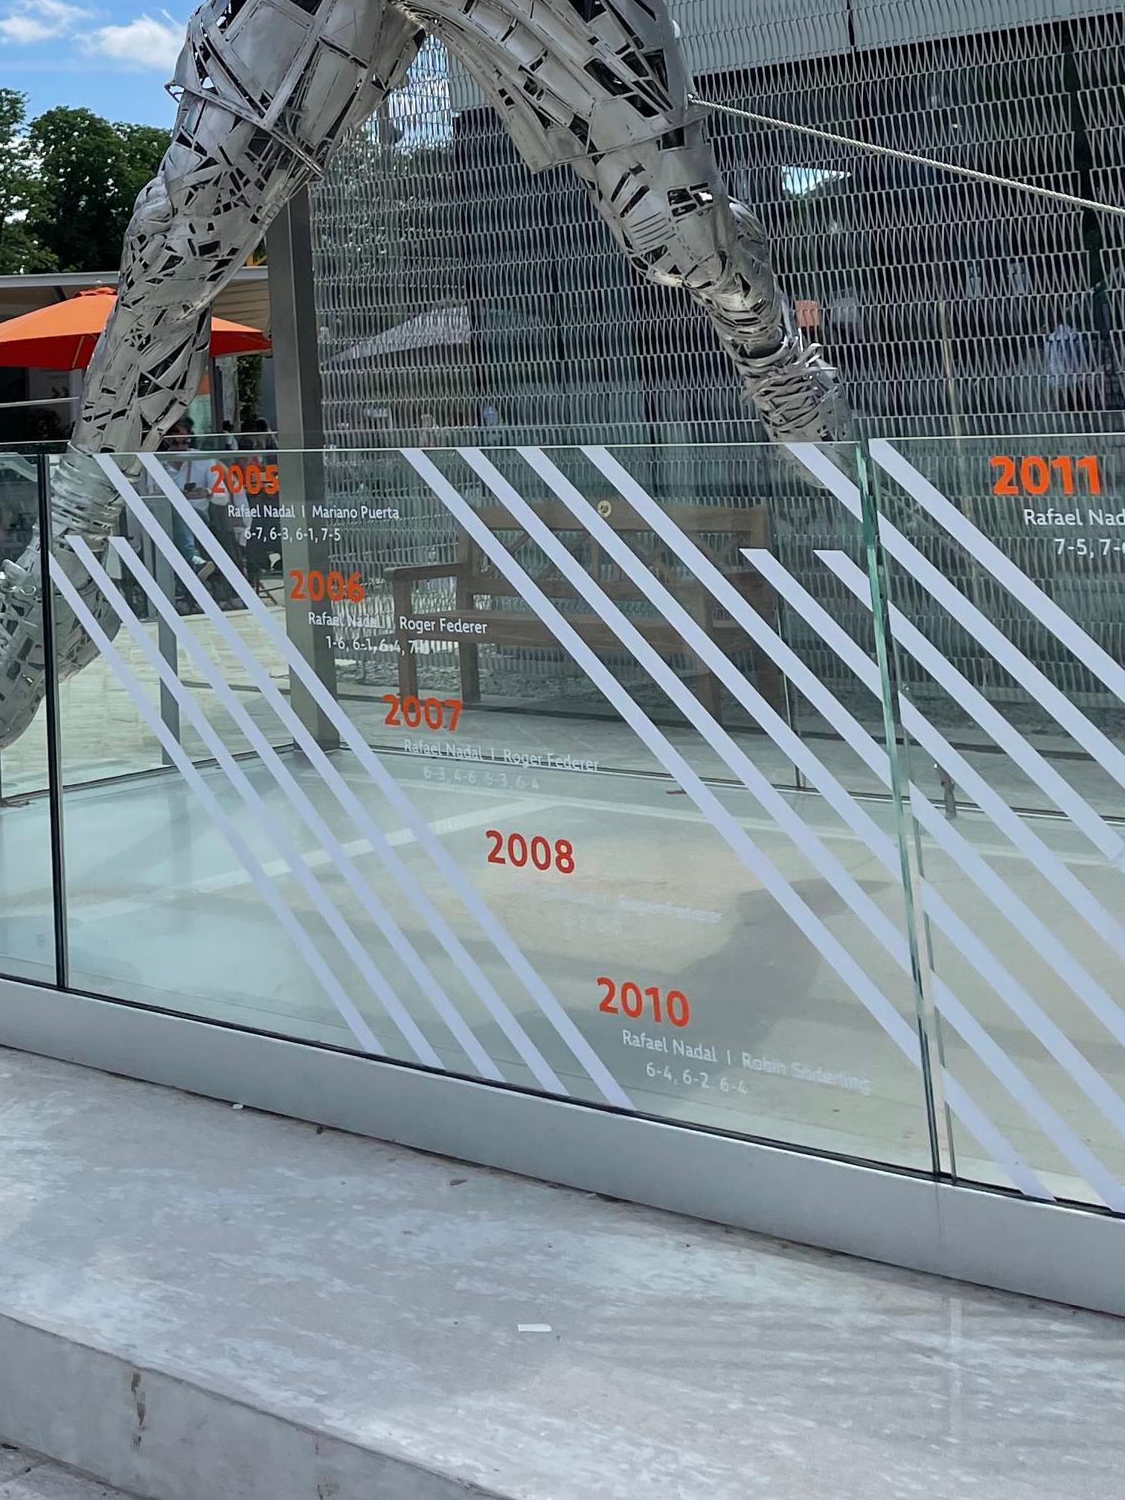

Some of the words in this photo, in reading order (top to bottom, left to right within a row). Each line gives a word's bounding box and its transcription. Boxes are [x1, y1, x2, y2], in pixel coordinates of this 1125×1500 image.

[210, 463, 279, 495] 2005
[989, 455, 1100, 495] 2011
[228, 505, 260, 519] Rafael
[264, 505, 295, 519] Nadal
[312, 506, 357, 519] Mariano
[361, 507, 399, 519] Puerta
[1024, 508, 1083, 526] Rafael
[244, 527, 267, 543] 6-7,
[270, 527, 293, 543] 6-3,
[296, 527, 318, 544] 6-1,
[321, 528, 341, 541] 7-5
[1054, 538, 1094, 559] 7-5,
[288, 569, 364, 604] 2006
[309, 612, 343, 627] Rafael
[400, 616, 435, 634] Roger
[440, 618, 487, 634] Federer
[382, 694, 463, 733] 2007
[404, 739, 442, 755] Rafael
[447, 744, 482, 760] Nadal
[503, 749, 542, 768] Roger
[548, 752, 599, 771] Federer
[485, 829, 575, 874] 2008
[596, 976, 690, 1028] 2010
[622, 1029, 668, 1053] Rafael
[673, 1039, 717, 1062] Nadal
